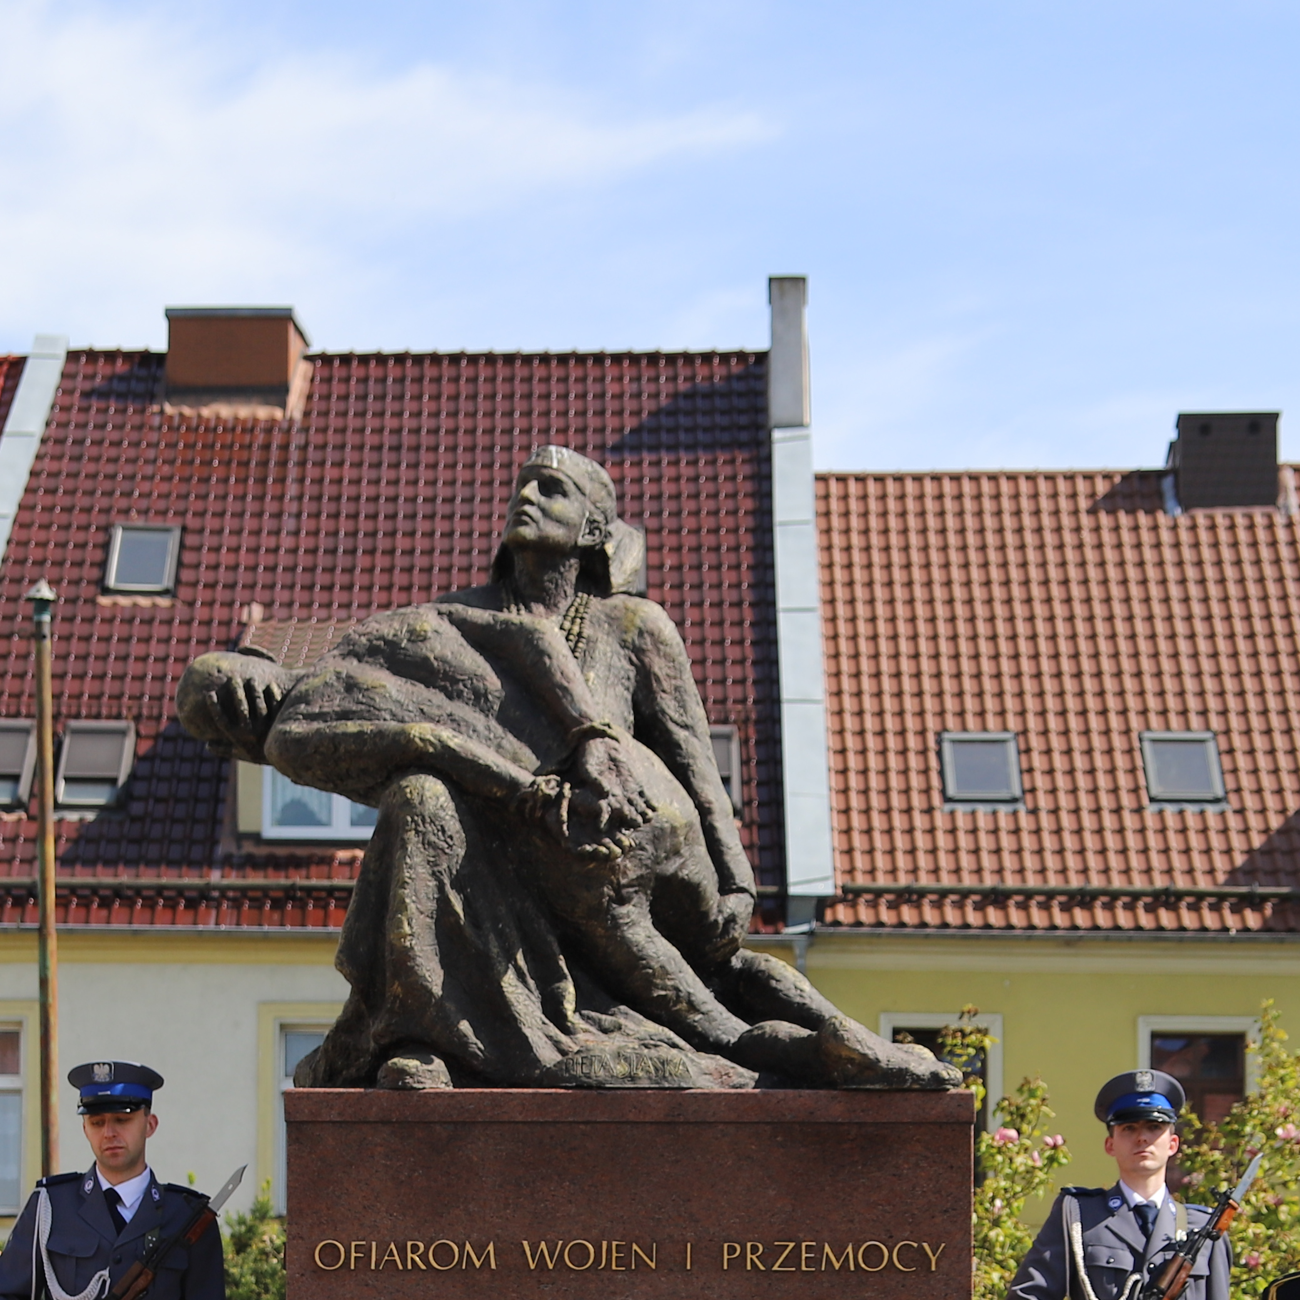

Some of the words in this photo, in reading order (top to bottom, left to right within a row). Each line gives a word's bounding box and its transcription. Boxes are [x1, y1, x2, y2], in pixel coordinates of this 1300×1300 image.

[313, 1239, 498, 1272] OFIAROM
[521, 1239, 658, 1272] WOJEN
[684, 1240, 693, 1271] I
[722, 1239, 946, 1273] PRZEMOCY
